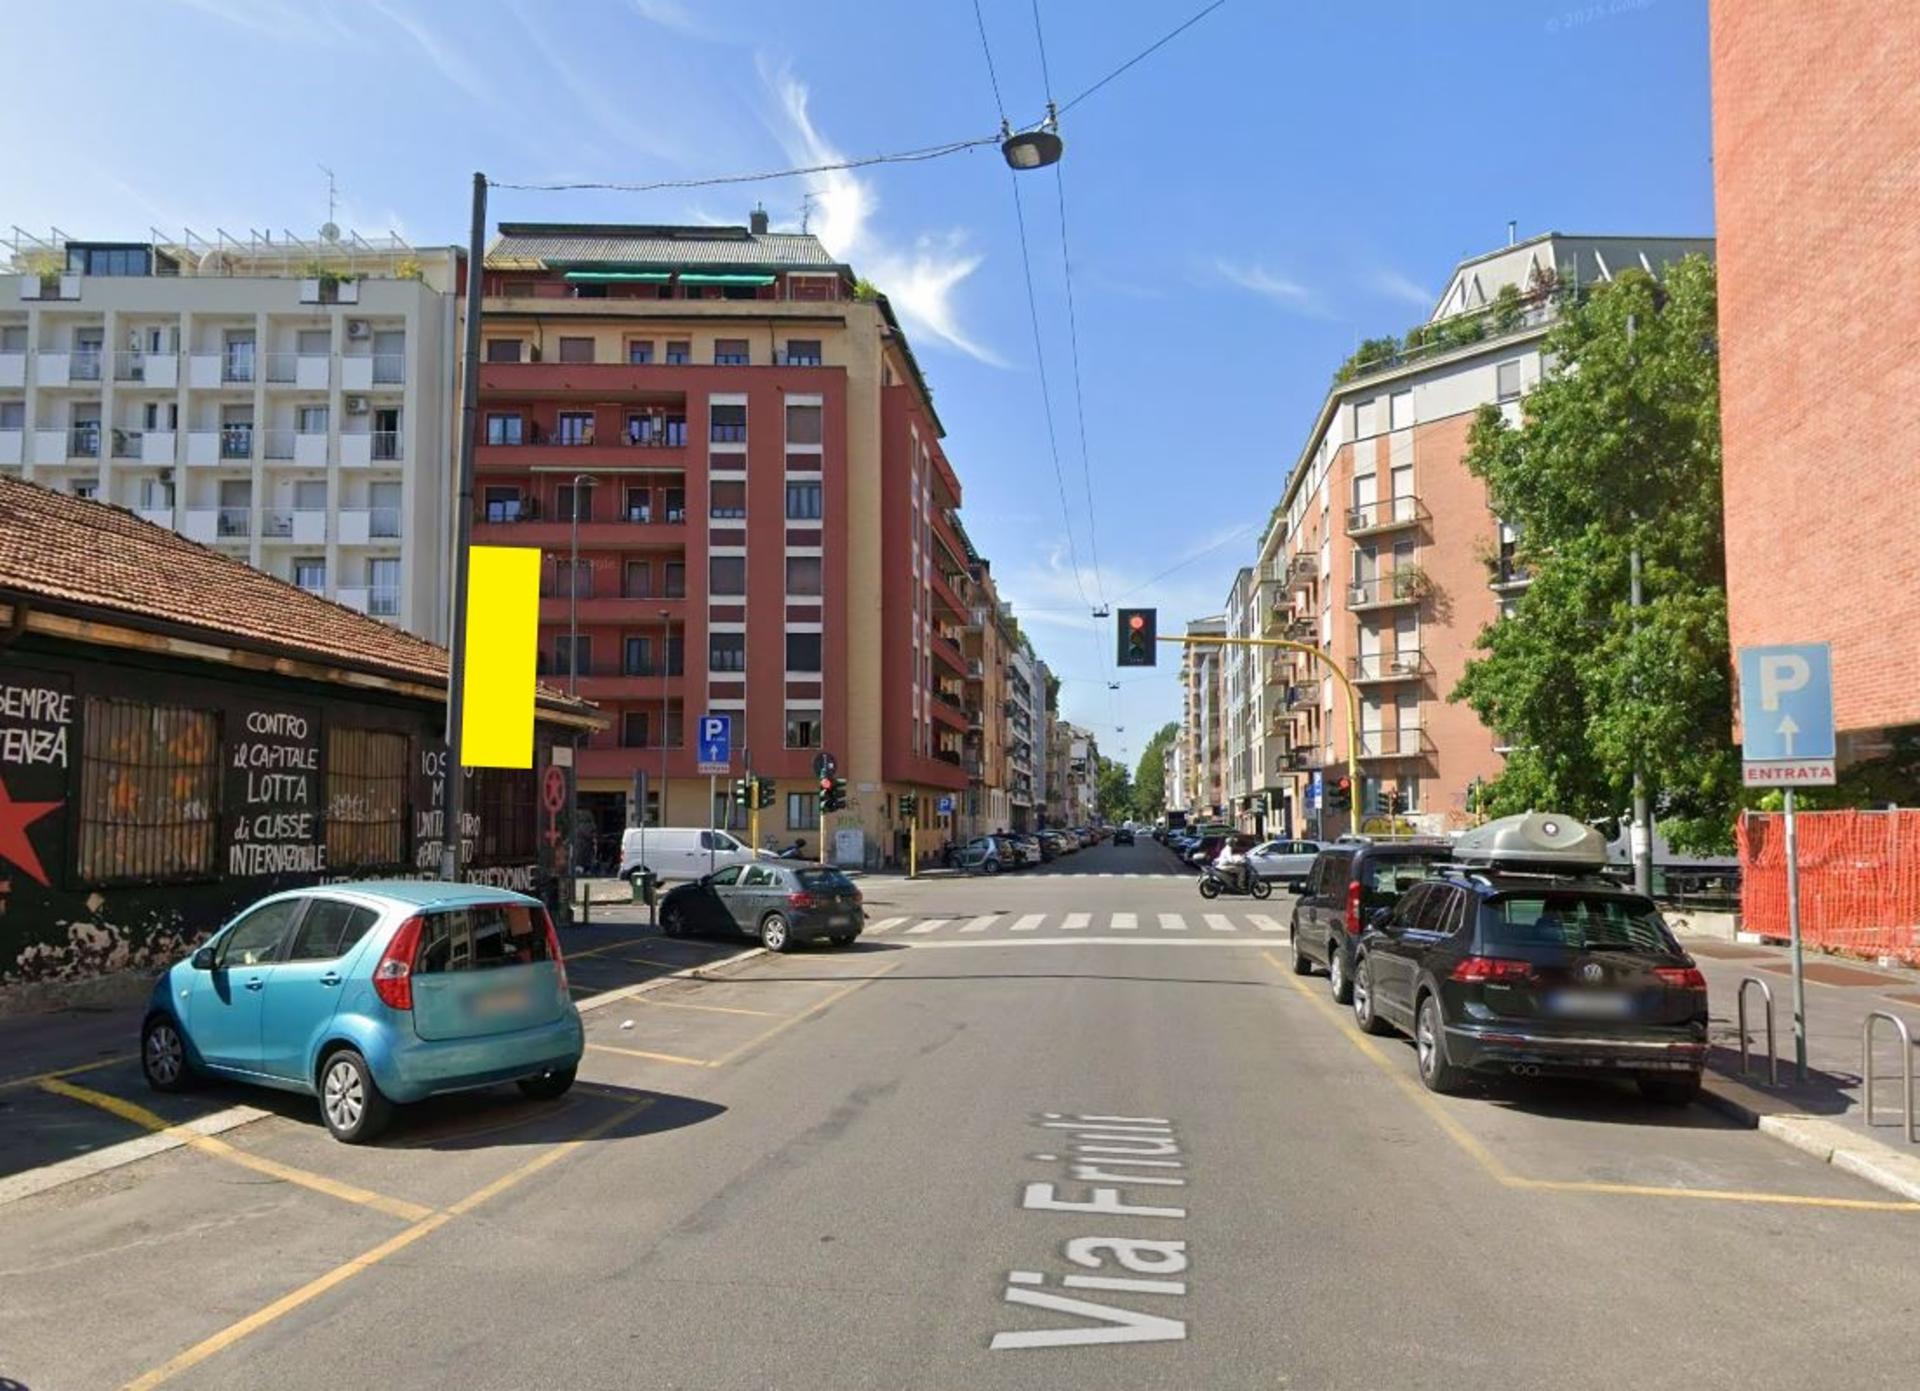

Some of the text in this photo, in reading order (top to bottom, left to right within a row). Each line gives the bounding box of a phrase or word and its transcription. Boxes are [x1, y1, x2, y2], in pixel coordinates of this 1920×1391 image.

[1760, 655, 1810, 711] P
[246, 712, 307, 739] CONTRO
[705, 719, 723, 741] P
[250, 744, 320, 770] CAPITALE
[1747, 767, 1832, 780] ENTRATA
[247, 771, 307, 804] LOTTA
[234, 813, 312, 841] di CLASSE
